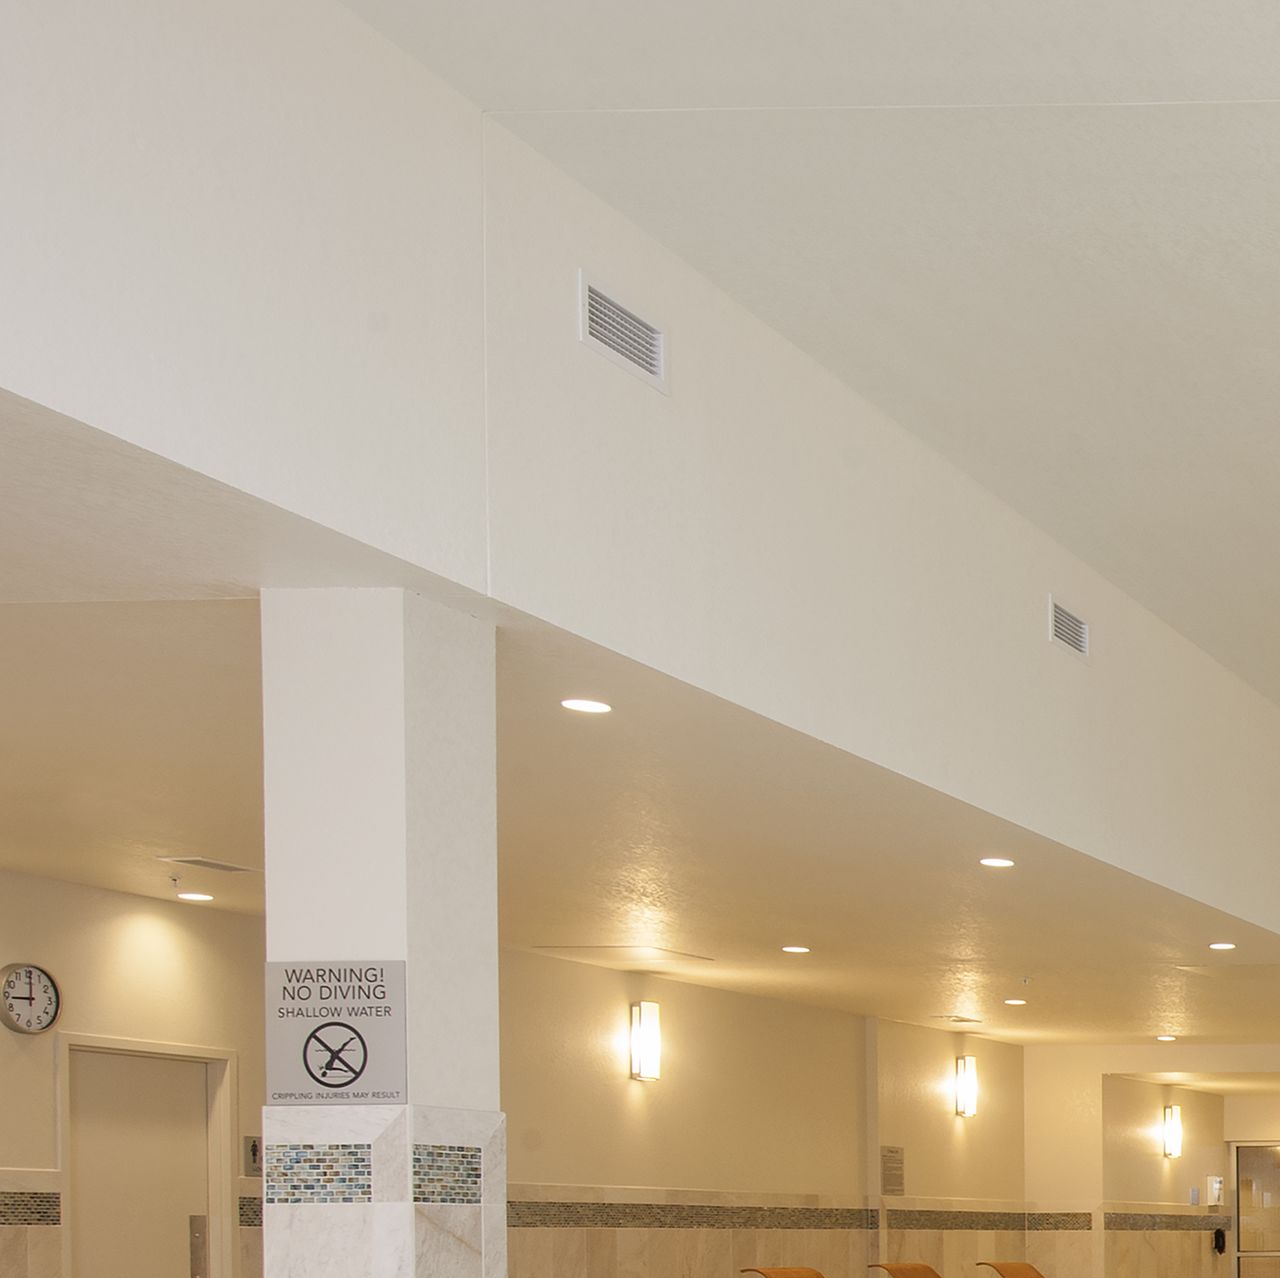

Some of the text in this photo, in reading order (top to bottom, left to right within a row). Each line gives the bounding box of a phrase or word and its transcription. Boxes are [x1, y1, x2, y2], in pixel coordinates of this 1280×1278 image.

[285, 967, 384, 983] WARNING!
[43, 985, 49, 994] 2
[282, 984, 386, 1001] NO DIVING
[4, 991, 10, 1000] 9
[47, 997, 53, 1006] 3
[8, 1003, 14, 1012] 8
[43, 1006, 49, 1015] 4
[278, 1005, 392, 1018] SHALLOW WATER
[15, 1013, 21, 1022] 7
[36, 1015, 42, 1025] 5
[26, 1020, 32, 1028] 6
[271, 1091, 400, 1100] CRIPPLING INJURIES MAY RESULT
